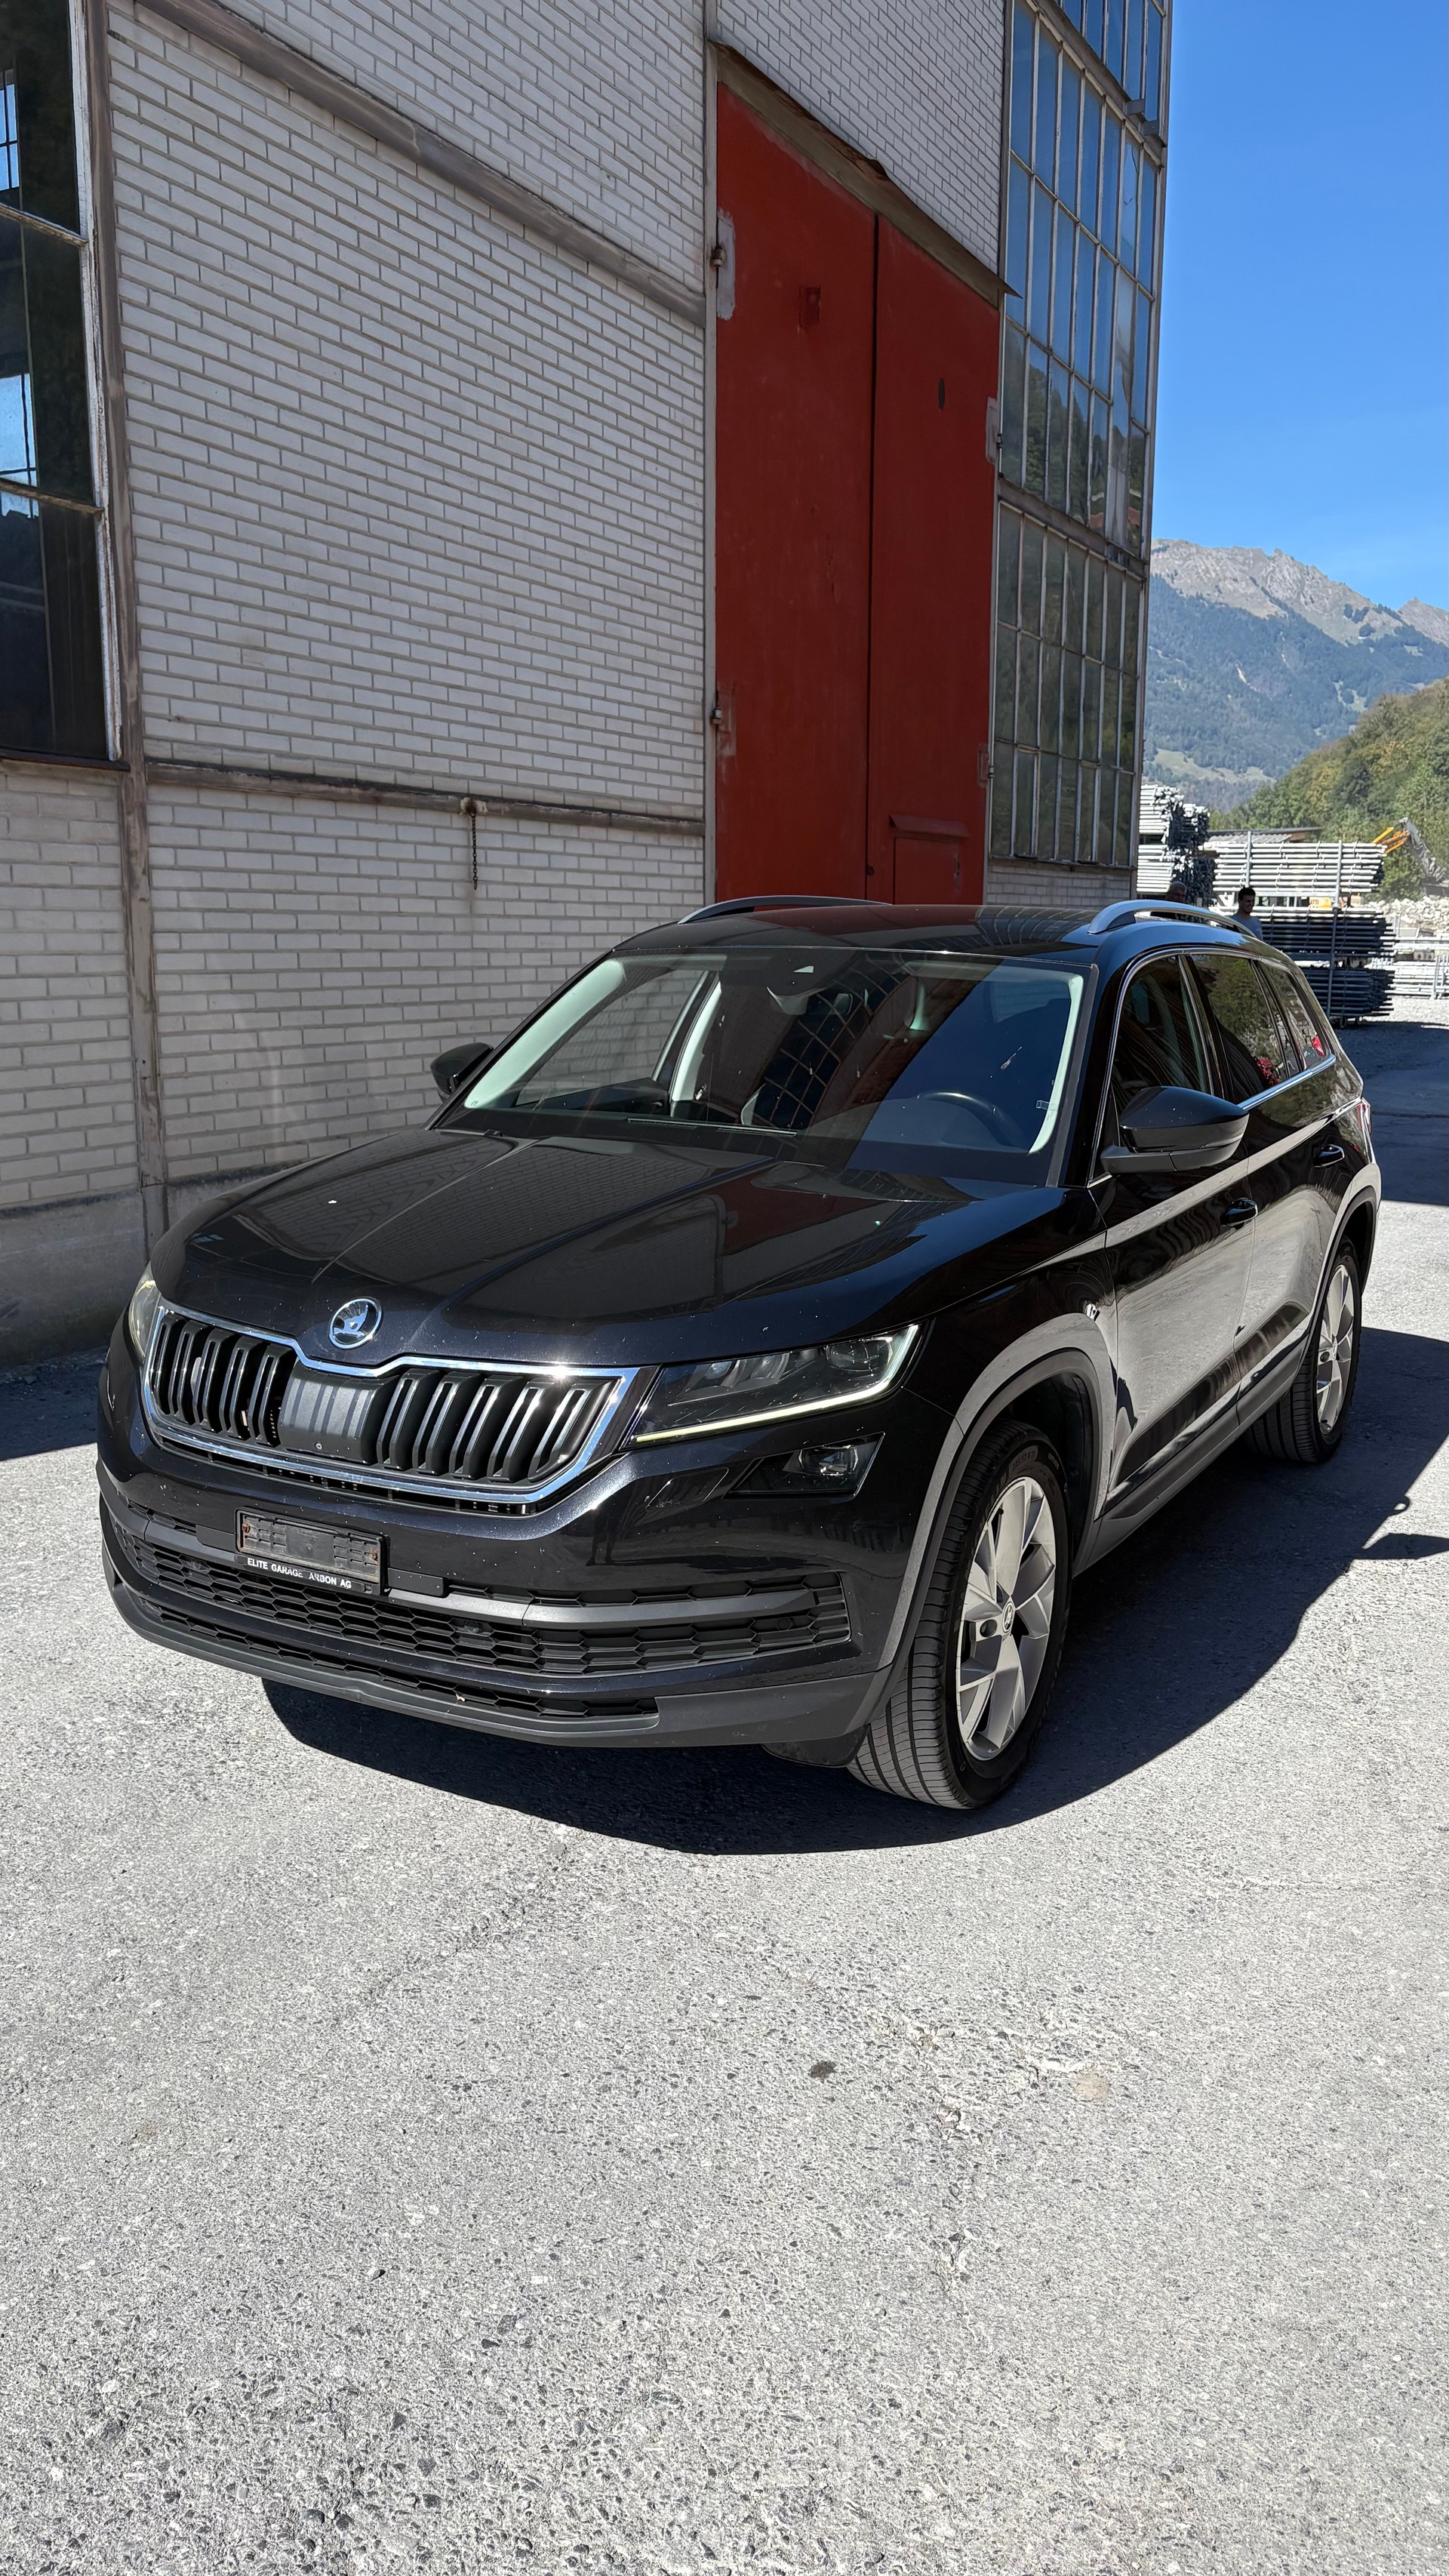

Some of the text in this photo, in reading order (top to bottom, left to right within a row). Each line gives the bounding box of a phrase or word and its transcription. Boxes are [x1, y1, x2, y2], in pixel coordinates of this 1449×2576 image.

[247, 1557, 352, 1590] ELITE GARAGE ARBON AG
